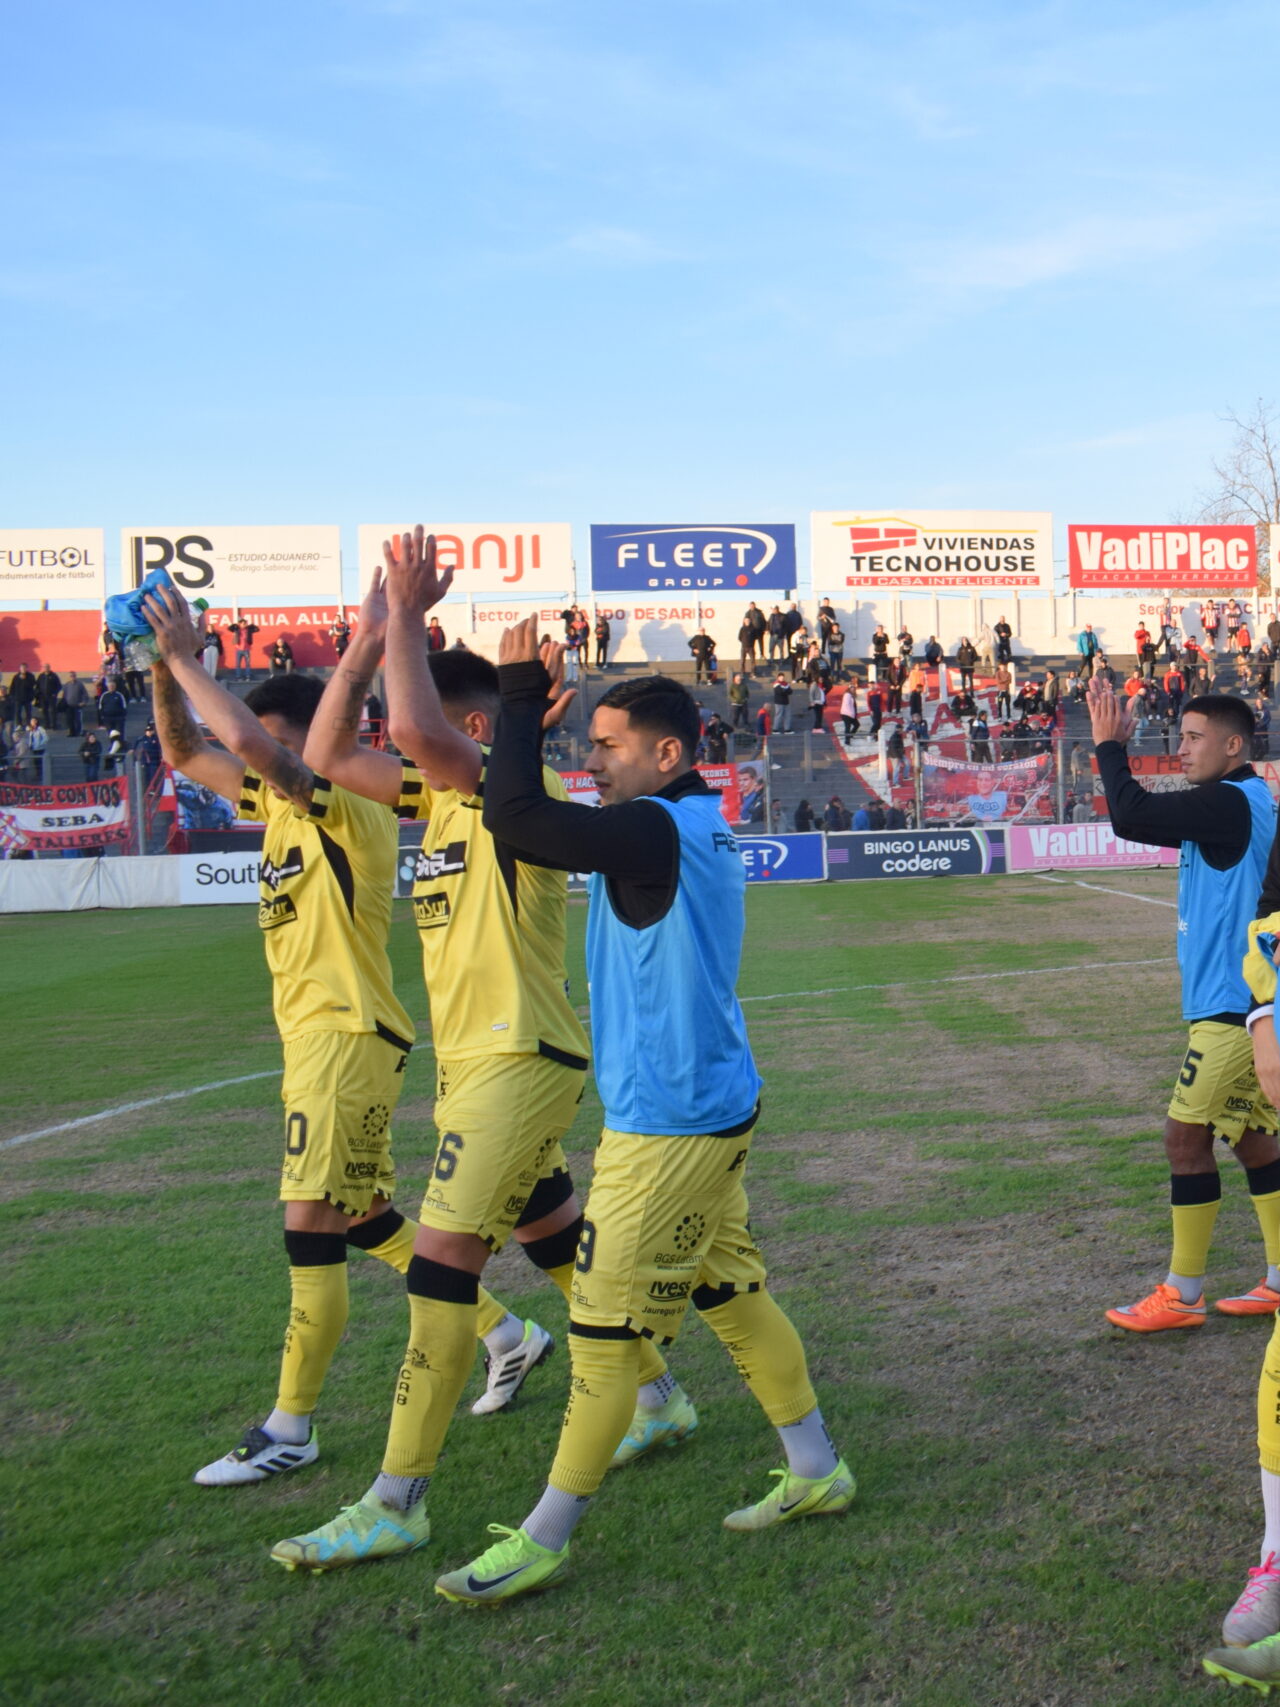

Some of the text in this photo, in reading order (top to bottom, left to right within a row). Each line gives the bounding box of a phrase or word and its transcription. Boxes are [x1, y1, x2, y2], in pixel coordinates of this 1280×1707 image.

[923, 537, 1035, 550] VIVIENDAS
[1075, 531, 1249, 571] VadiPlac
[228, 552, 320, 562] ESTUDIO ADUANERO
[618, 543, 752, 568] FLEET
[850, 556, 1035, 572] TECNOHOUSE
[648, 578, 724, 587] GROUP
[850, 576, 1036, 586] TU CASA INTELIGENTE
[57, 787, 88, 805] CON
[91, 781, 121, 808] VOS
[42, 813, 105, 828] SEBA
[31, 829, 128, 848] TALLERES
[864, 838, 970, 855] BINGO LANUS
[882, 855, 951, 873] codere
[435, 1132, 465, 1182] 6
[576, 1219, 598, 1275] 9
